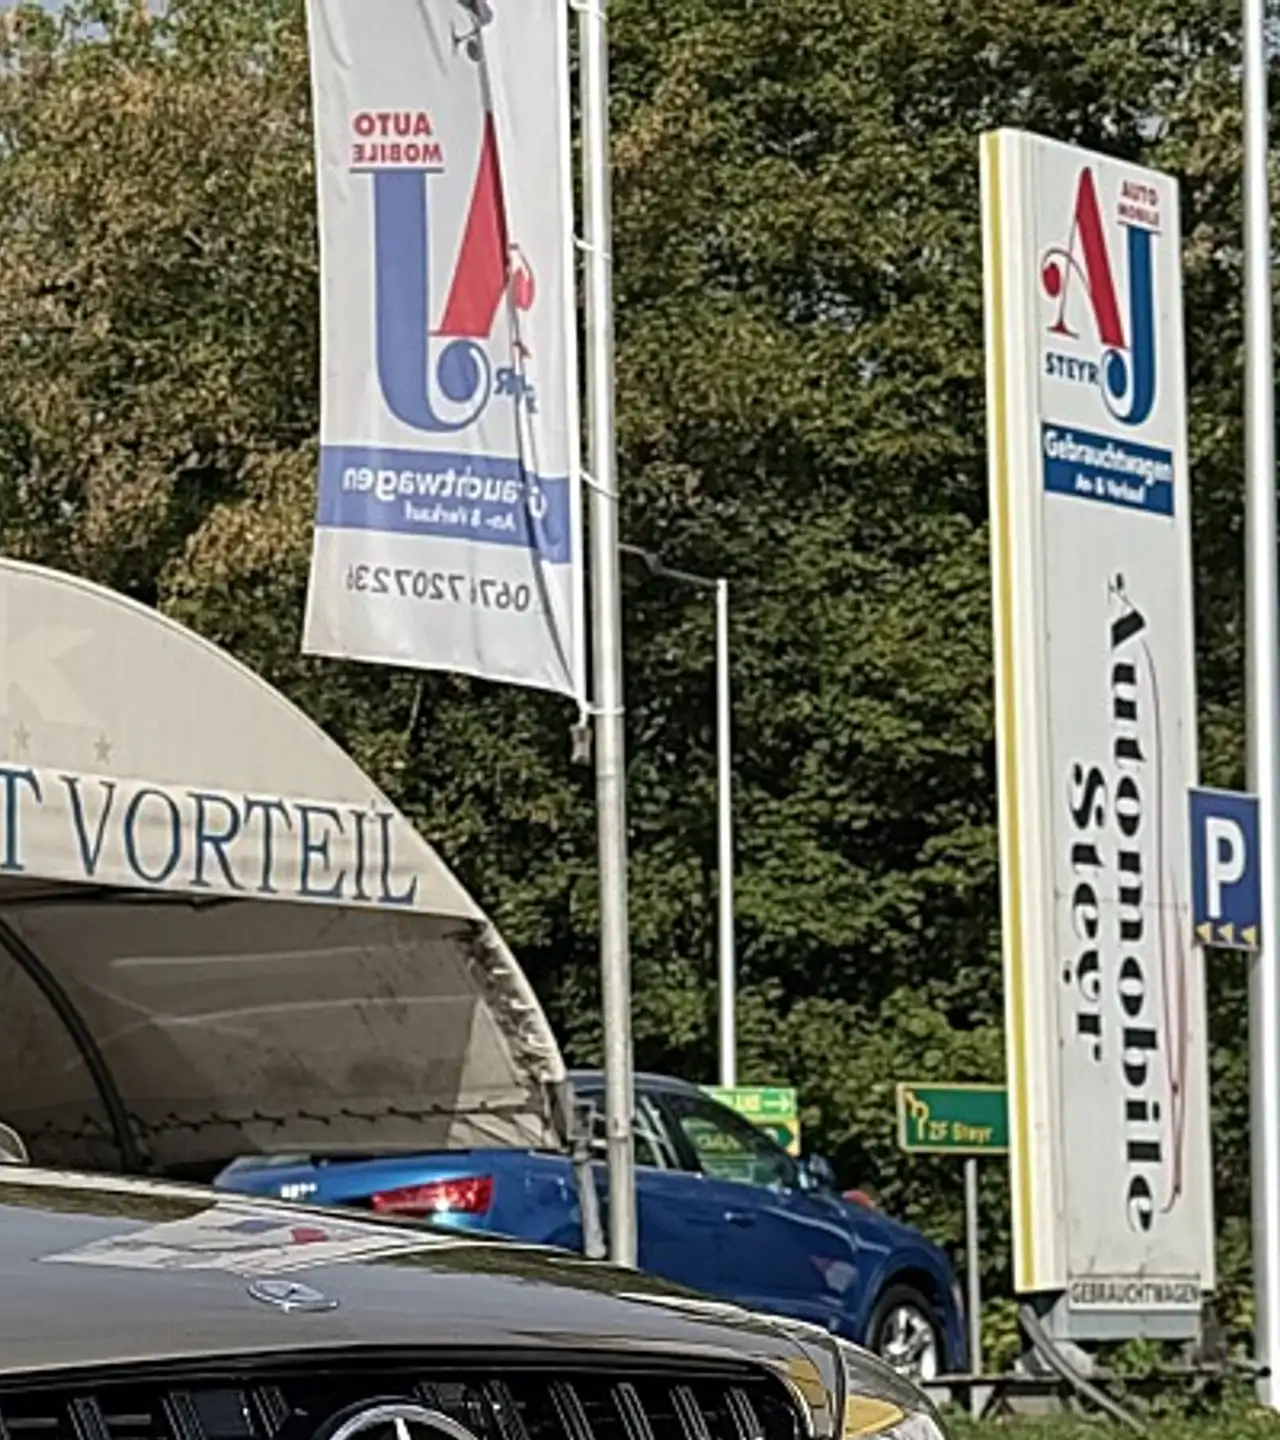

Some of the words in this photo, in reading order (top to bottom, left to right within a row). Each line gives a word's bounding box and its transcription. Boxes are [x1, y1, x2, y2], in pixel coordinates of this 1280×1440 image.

[1045, 352, 1100, 386] STEYR
[60, 774, 418, 905] VORTEIL
[1107, 572, 1161, 1234] Automobile
[1204, 816, 1247, 919] P
[1064, 762, 1109, 1063] Steyr
